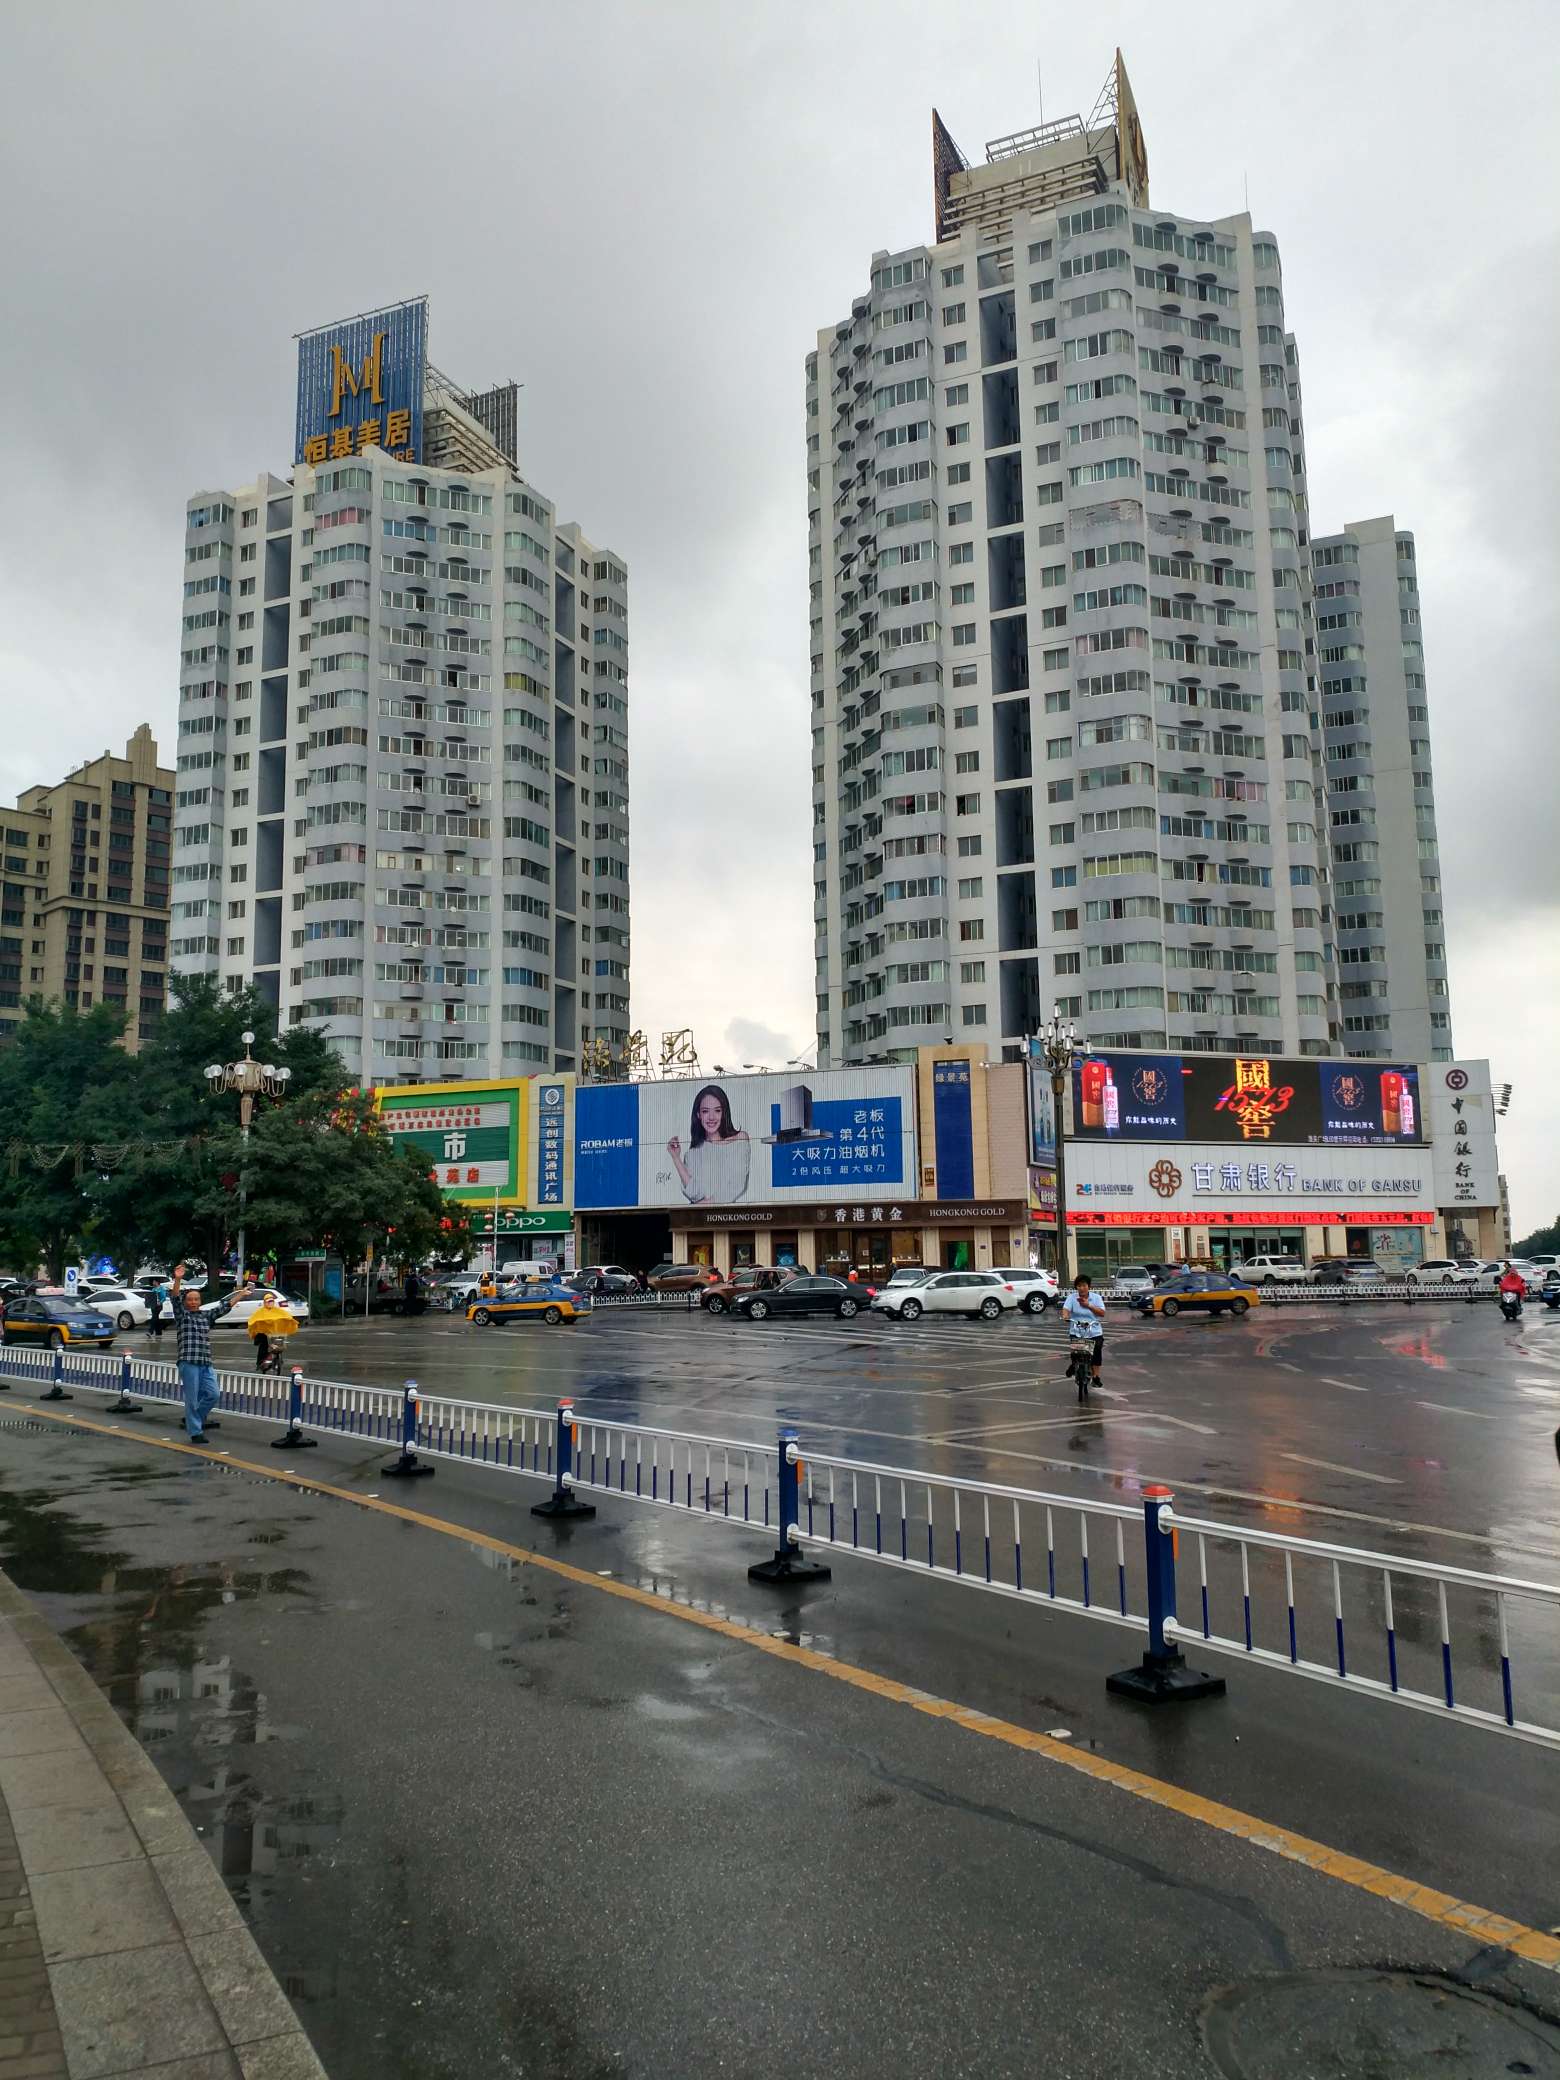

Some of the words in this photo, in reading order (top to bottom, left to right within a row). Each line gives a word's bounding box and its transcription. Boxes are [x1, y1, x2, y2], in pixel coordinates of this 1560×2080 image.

[304, 408, 412, 469] 恒基美居
[1235, 1059, 1270, 1093] 國
[1214, 1085, 1295, 1112] 1573
[854, 1108, 885, 1124] 老板
[1236, 1100, 1276, 1138] 窖
[839, 1125, 885, 1142] 第4代
[580, 1139, 615, 1150] ROBAM
[791, 1144, 886, 1161] 大吸力油烟机
[791, 1165, 833, 1176] 2倍风压
[839, 1163, 886, 1174] 超大吸力
[1191, 1162, 1297, 1192] 甘肃银行
[1302, 1179, 1344, 1192] BANK
[1348, 1178, 1366, 1192] OF
[1371, 1178, 1422, 1192] GANSU
[750, 1212, 773, 1221] GOLD
[834, 1206, 903, 1222] 香港黄金
[928, 1209, 979, 1217] HONGKONG
[980, 1207, 1005, 1216] GOLD
